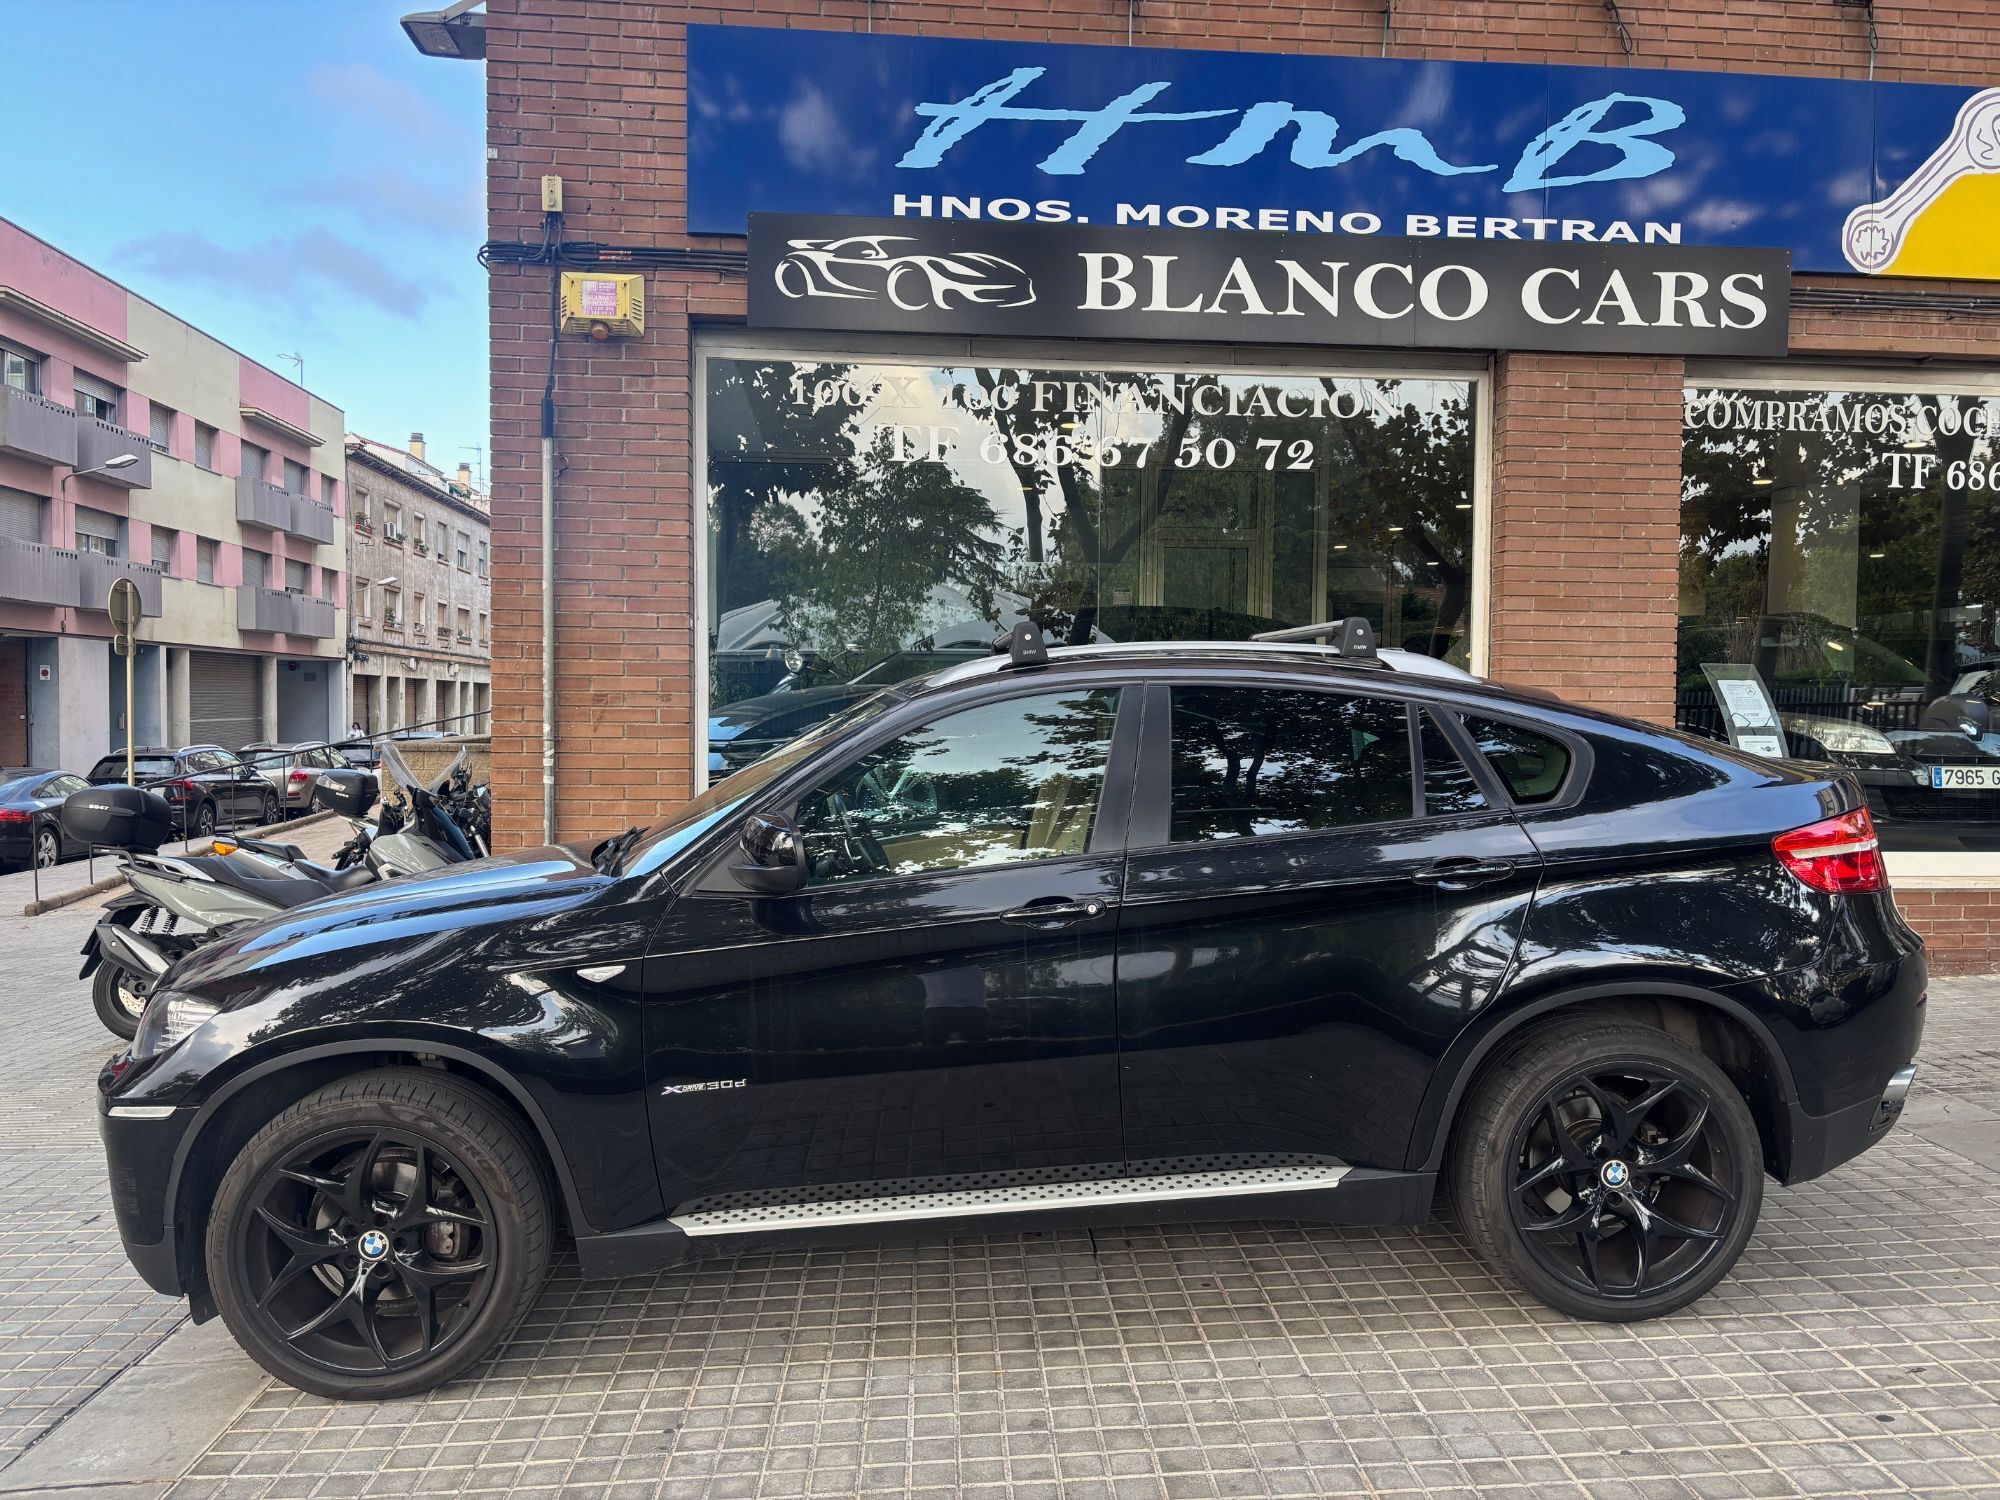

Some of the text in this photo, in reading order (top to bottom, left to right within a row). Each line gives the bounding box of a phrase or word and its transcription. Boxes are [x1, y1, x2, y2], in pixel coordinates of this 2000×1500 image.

[893, 194, 1681, 244] HNOS. MORENO BERTRAN
[1077, 252, 1767, 330] BLANCO CARS
[791, 378, 867, 406] 100
[881, 376, 919, 408] X
[939, 384, 1015, 411] 100
[1684, 399, 1905, 434] COMPRAMOS
[874, 424, 1314, 471] TF 686 67 50 72
[1882, 452, 1936, 489] TF
[1944, 769, 1985, 785] 7965
